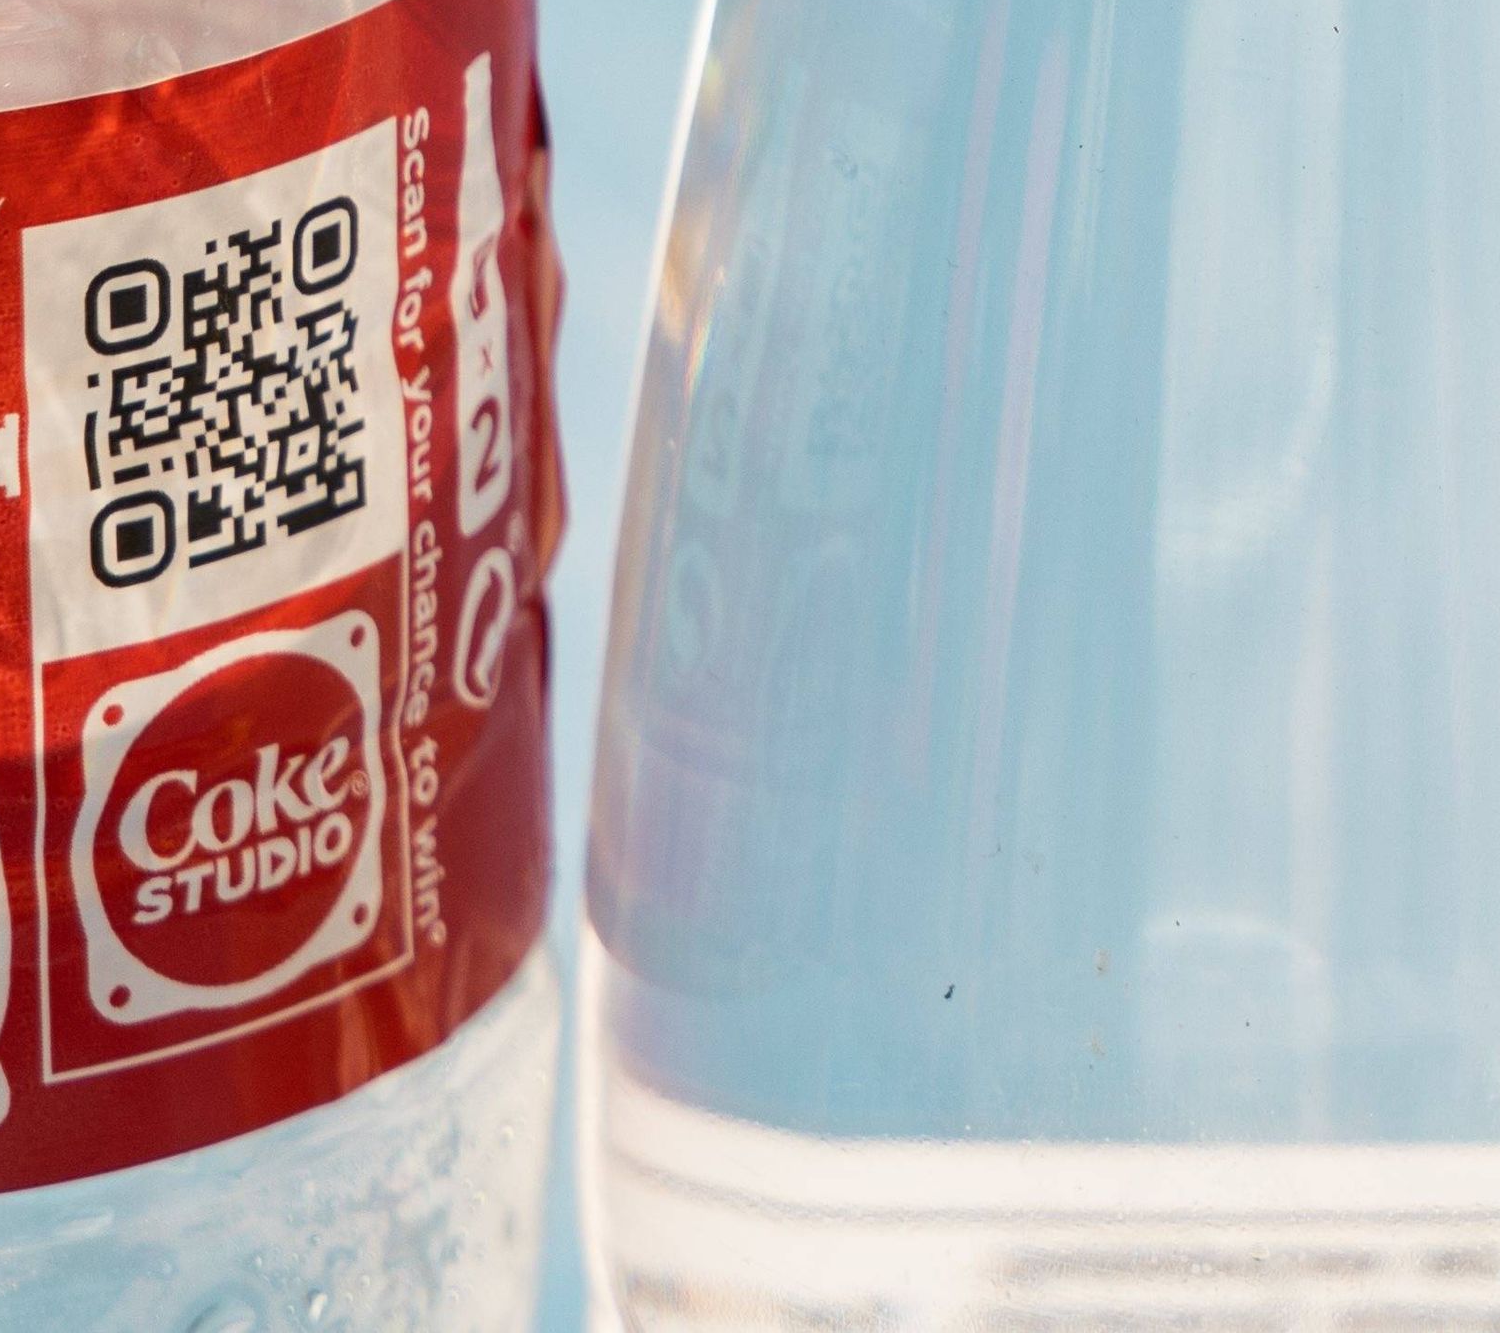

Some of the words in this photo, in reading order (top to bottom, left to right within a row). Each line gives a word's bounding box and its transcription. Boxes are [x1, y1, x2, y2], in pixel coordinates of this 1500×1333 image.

[404, 105, 430, 258] Scan
[399, 269, 433, 354] for
[402, 364, 434, 503] your
[405, 519, 443, 727] chance
[118, 735, 350, 874] Coke
[410, 735, 439, 807] to
[131, 811, 353, 926] STUDIO
